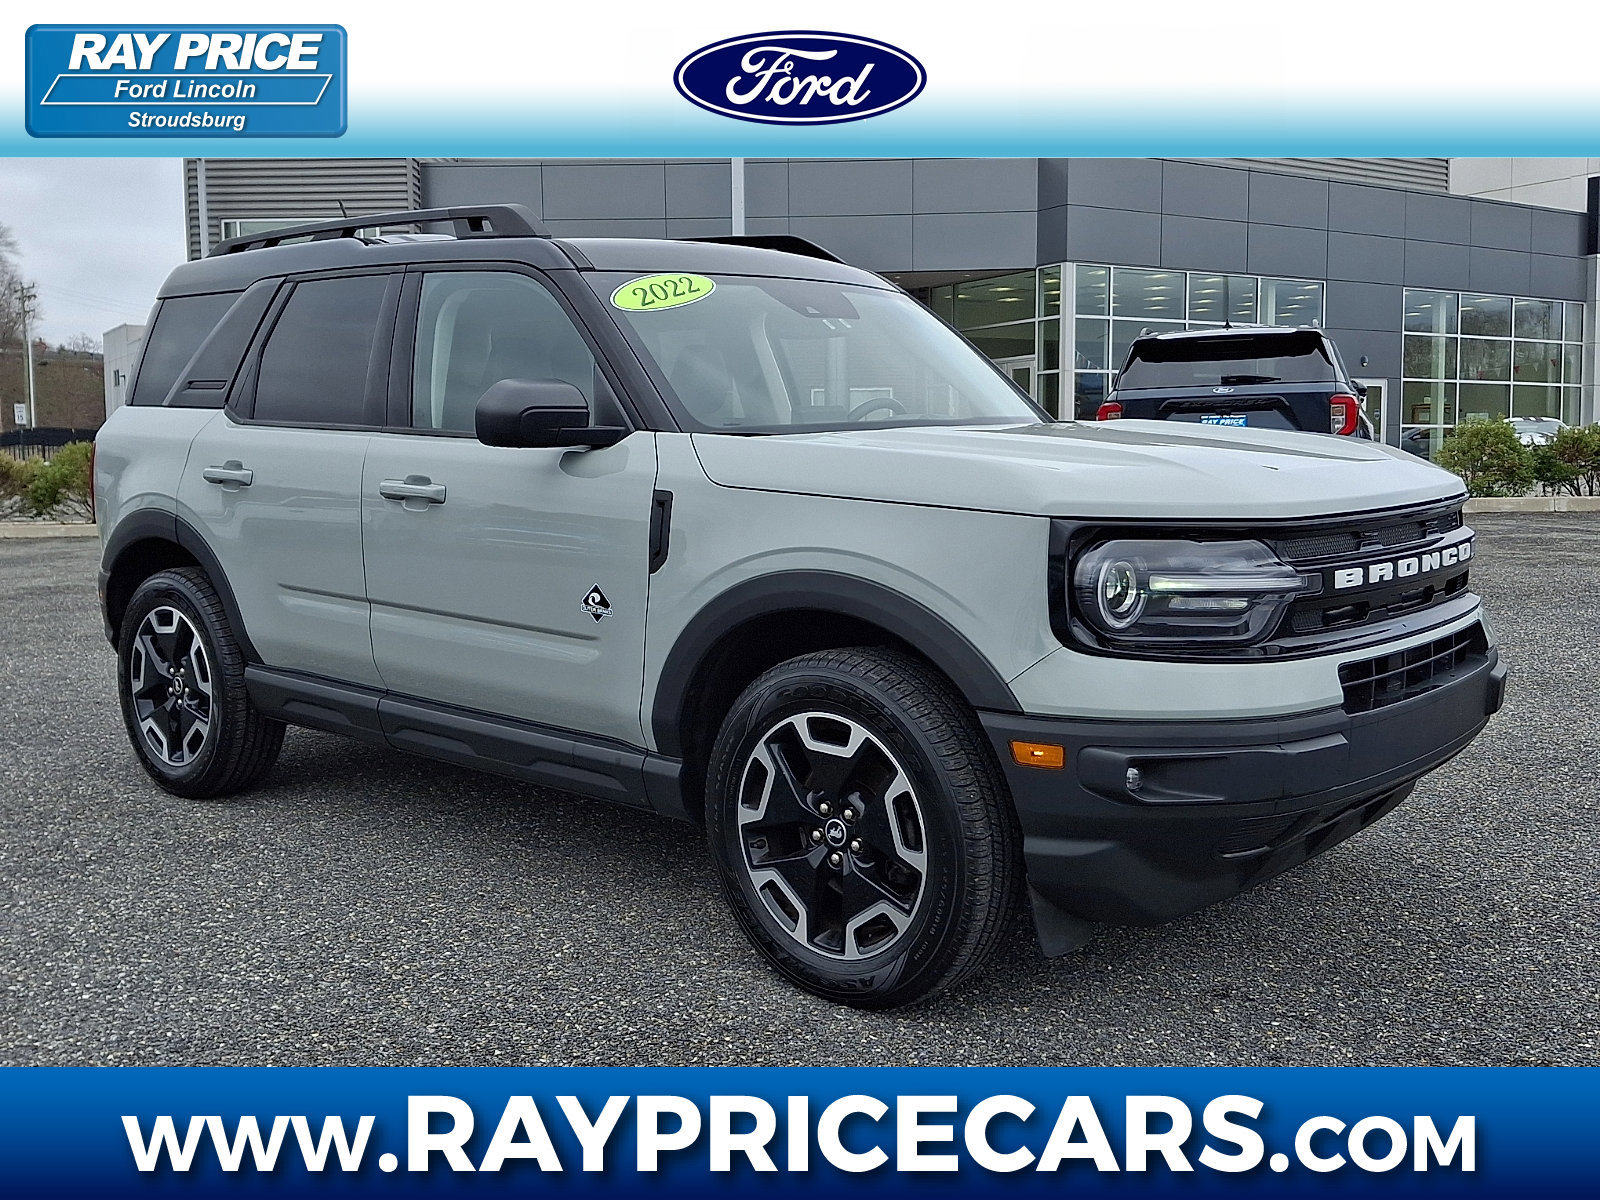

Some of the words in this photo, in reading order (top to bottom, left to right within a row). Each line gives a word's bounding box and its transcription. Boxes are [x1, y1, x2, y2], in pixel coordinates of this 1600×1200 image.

[632, 276, 700, 306] 2022
[1219, 418, 1245, 426] PRICE
[1334, 542, 1471, 589] BRONCO
